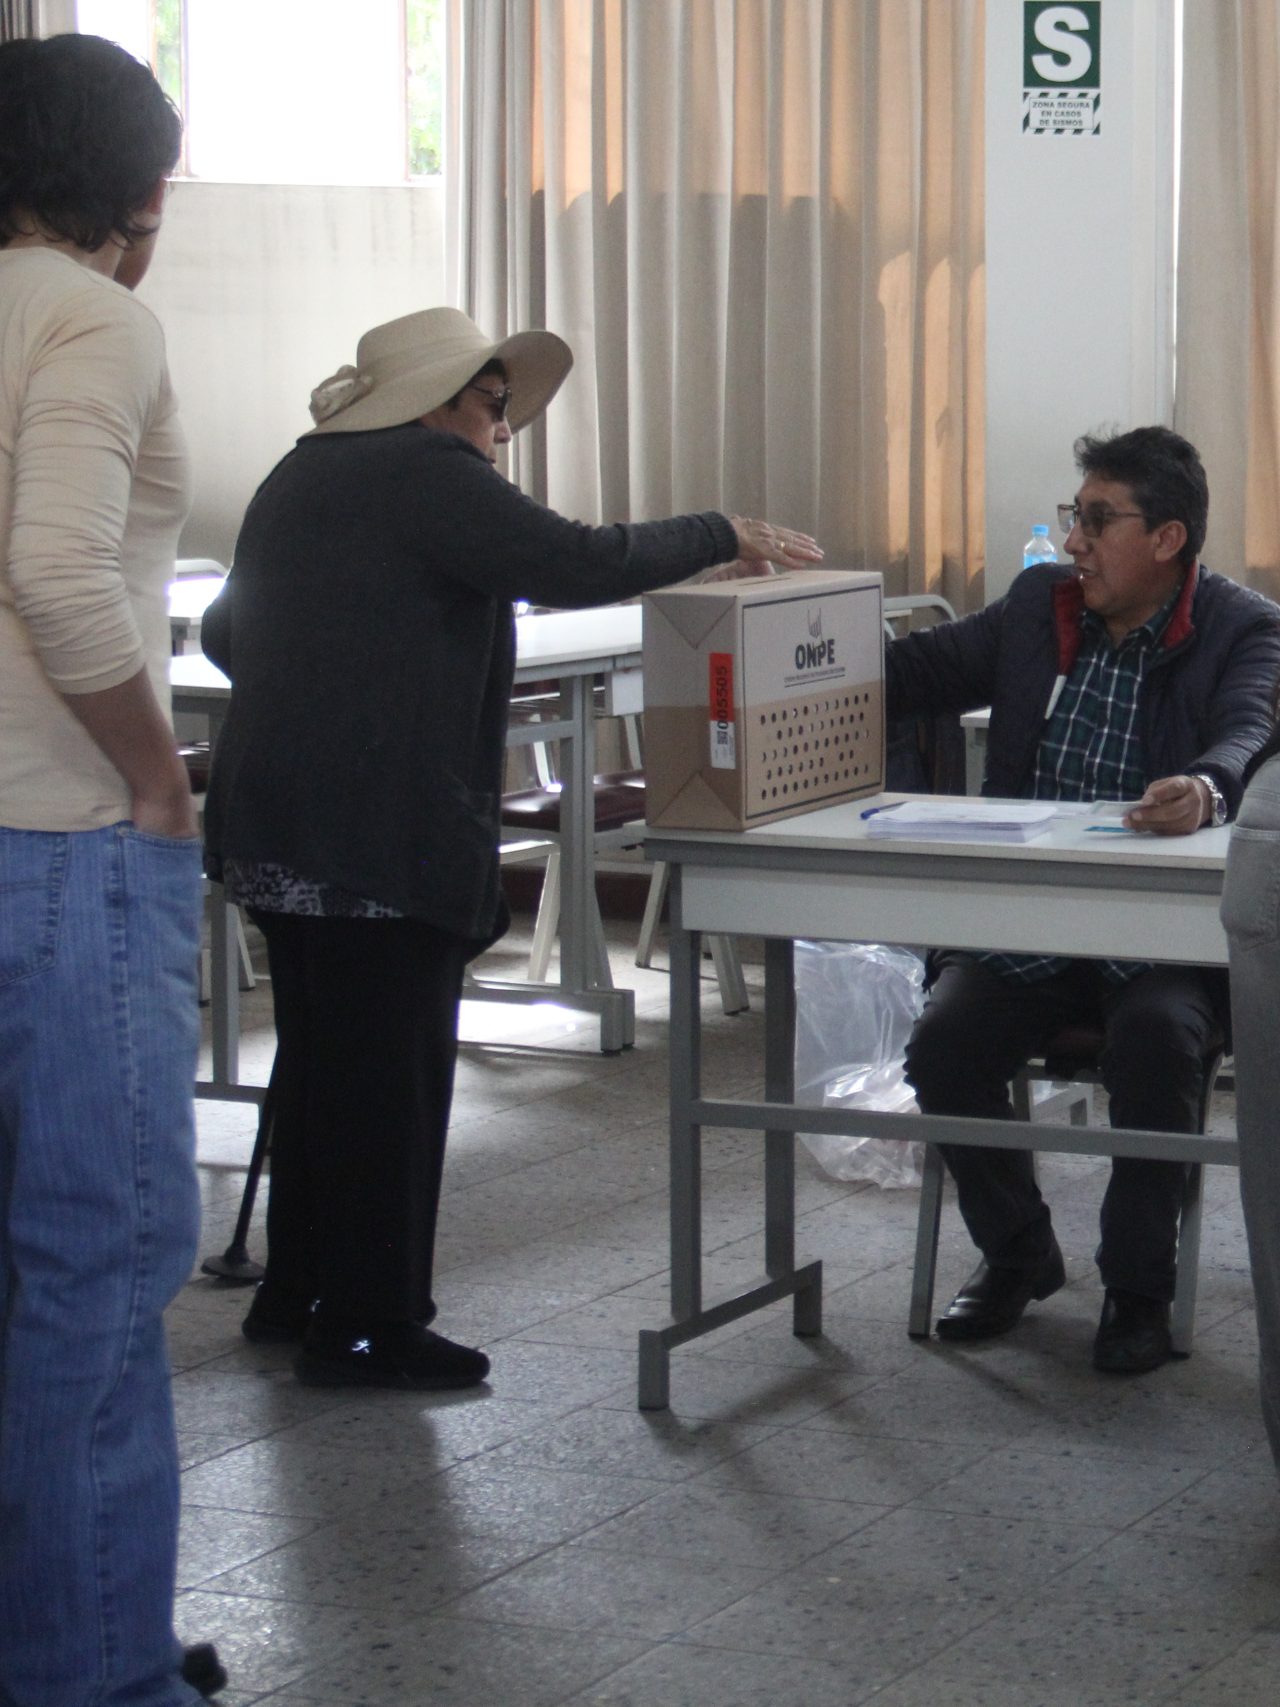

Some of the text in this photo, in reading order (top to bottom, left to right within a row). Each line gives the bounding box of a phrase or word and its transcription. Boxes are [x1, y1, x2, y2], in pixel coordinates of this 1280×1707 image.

[1031, 6, 1092, 82] S
[1040, 119, 1050, 127] DE
[795, 639, 835, 670] ONPE
